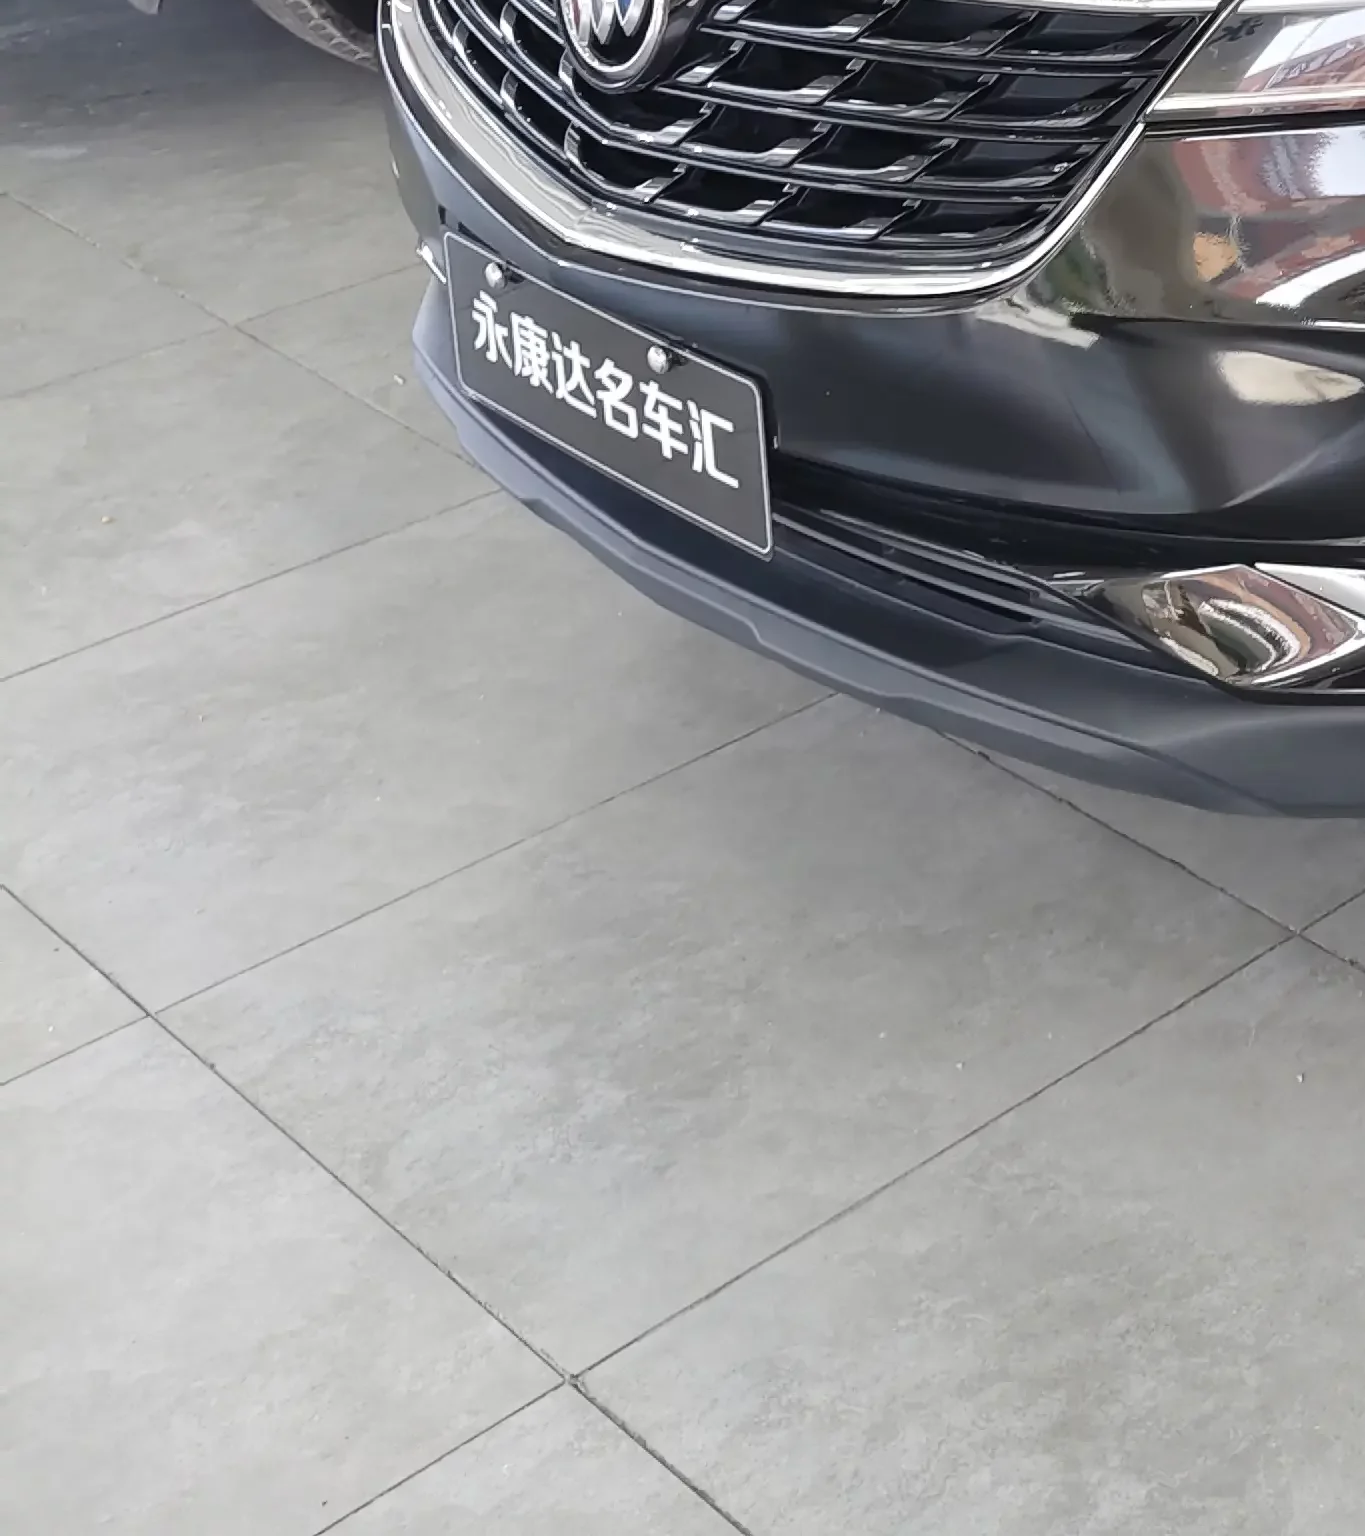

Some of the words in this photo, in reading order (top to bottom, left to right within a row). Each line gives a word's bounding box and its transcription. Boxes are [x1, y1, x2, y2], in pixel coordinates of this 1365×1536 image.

[472, 290, 740, 489] 永康达名车汇
